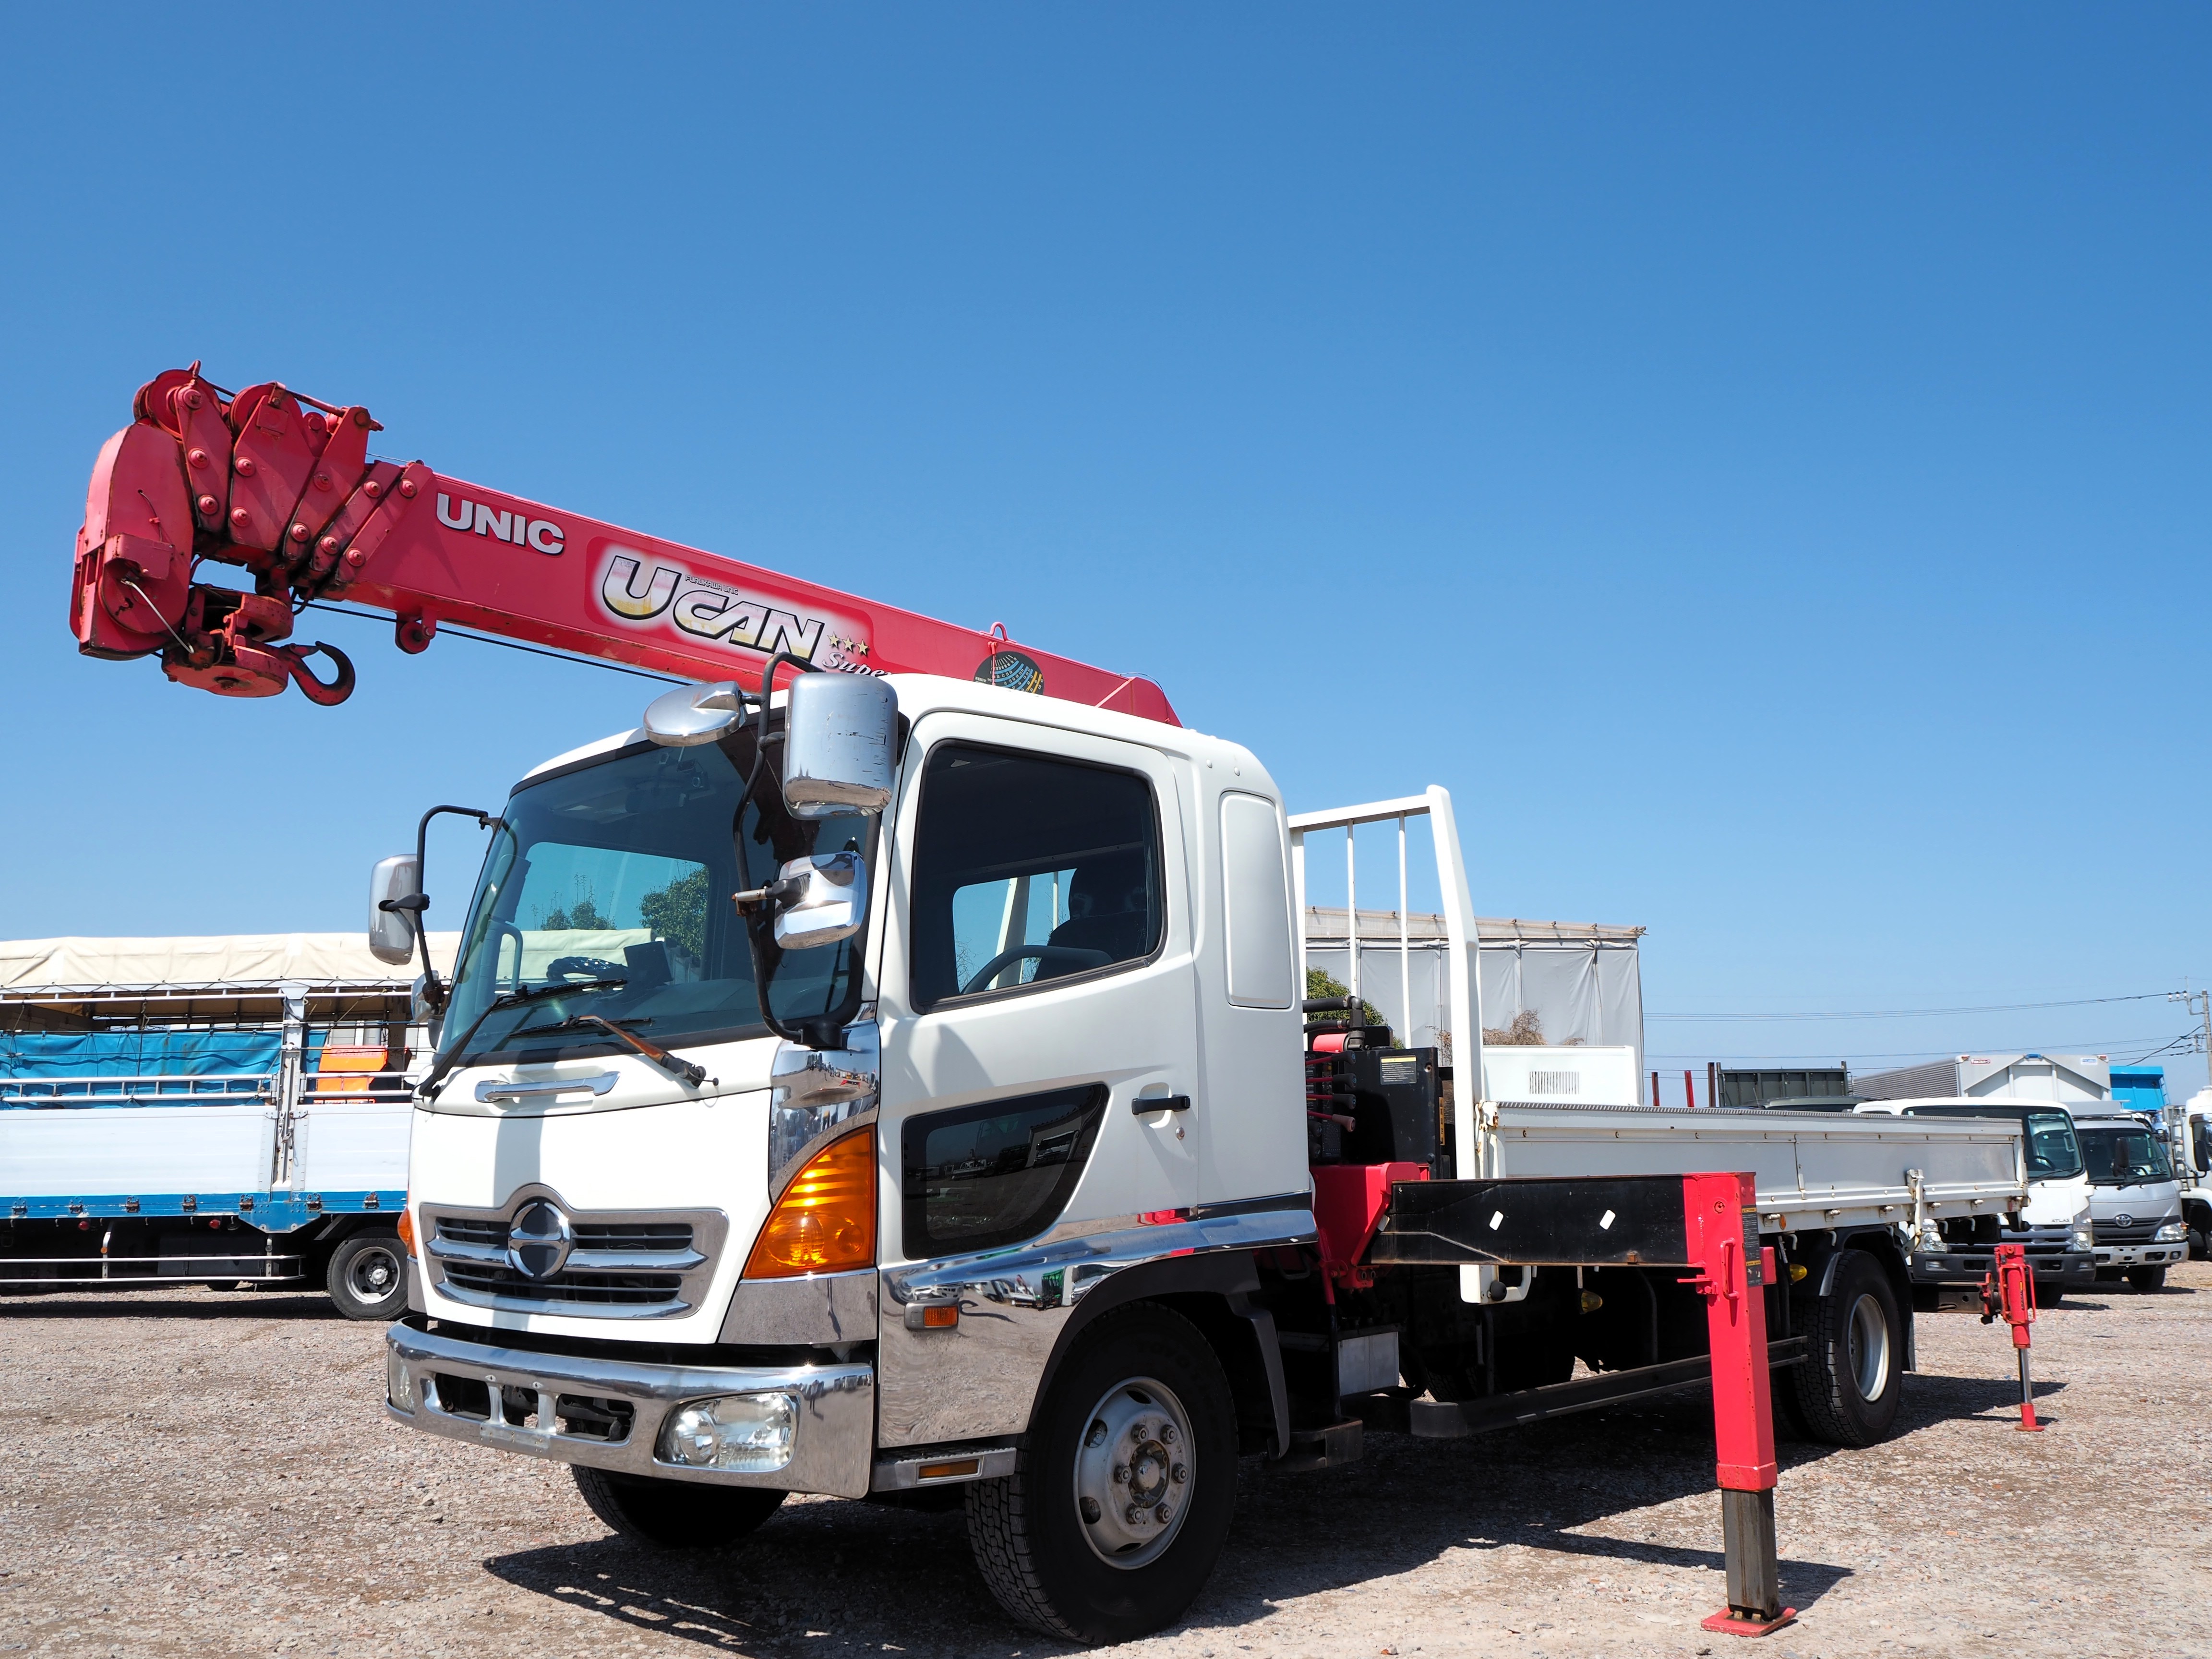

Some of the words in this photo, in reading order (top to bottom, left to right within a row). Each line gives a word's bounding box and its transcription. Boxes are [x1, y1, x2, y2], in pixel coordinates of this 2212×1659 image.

[436, 491, 565, 555] UNIC
[601, 554, 825, 660] UCAN
[685, 575, 722, 591] FURUKAWA
[723, 585, 739, 595] UNIC
